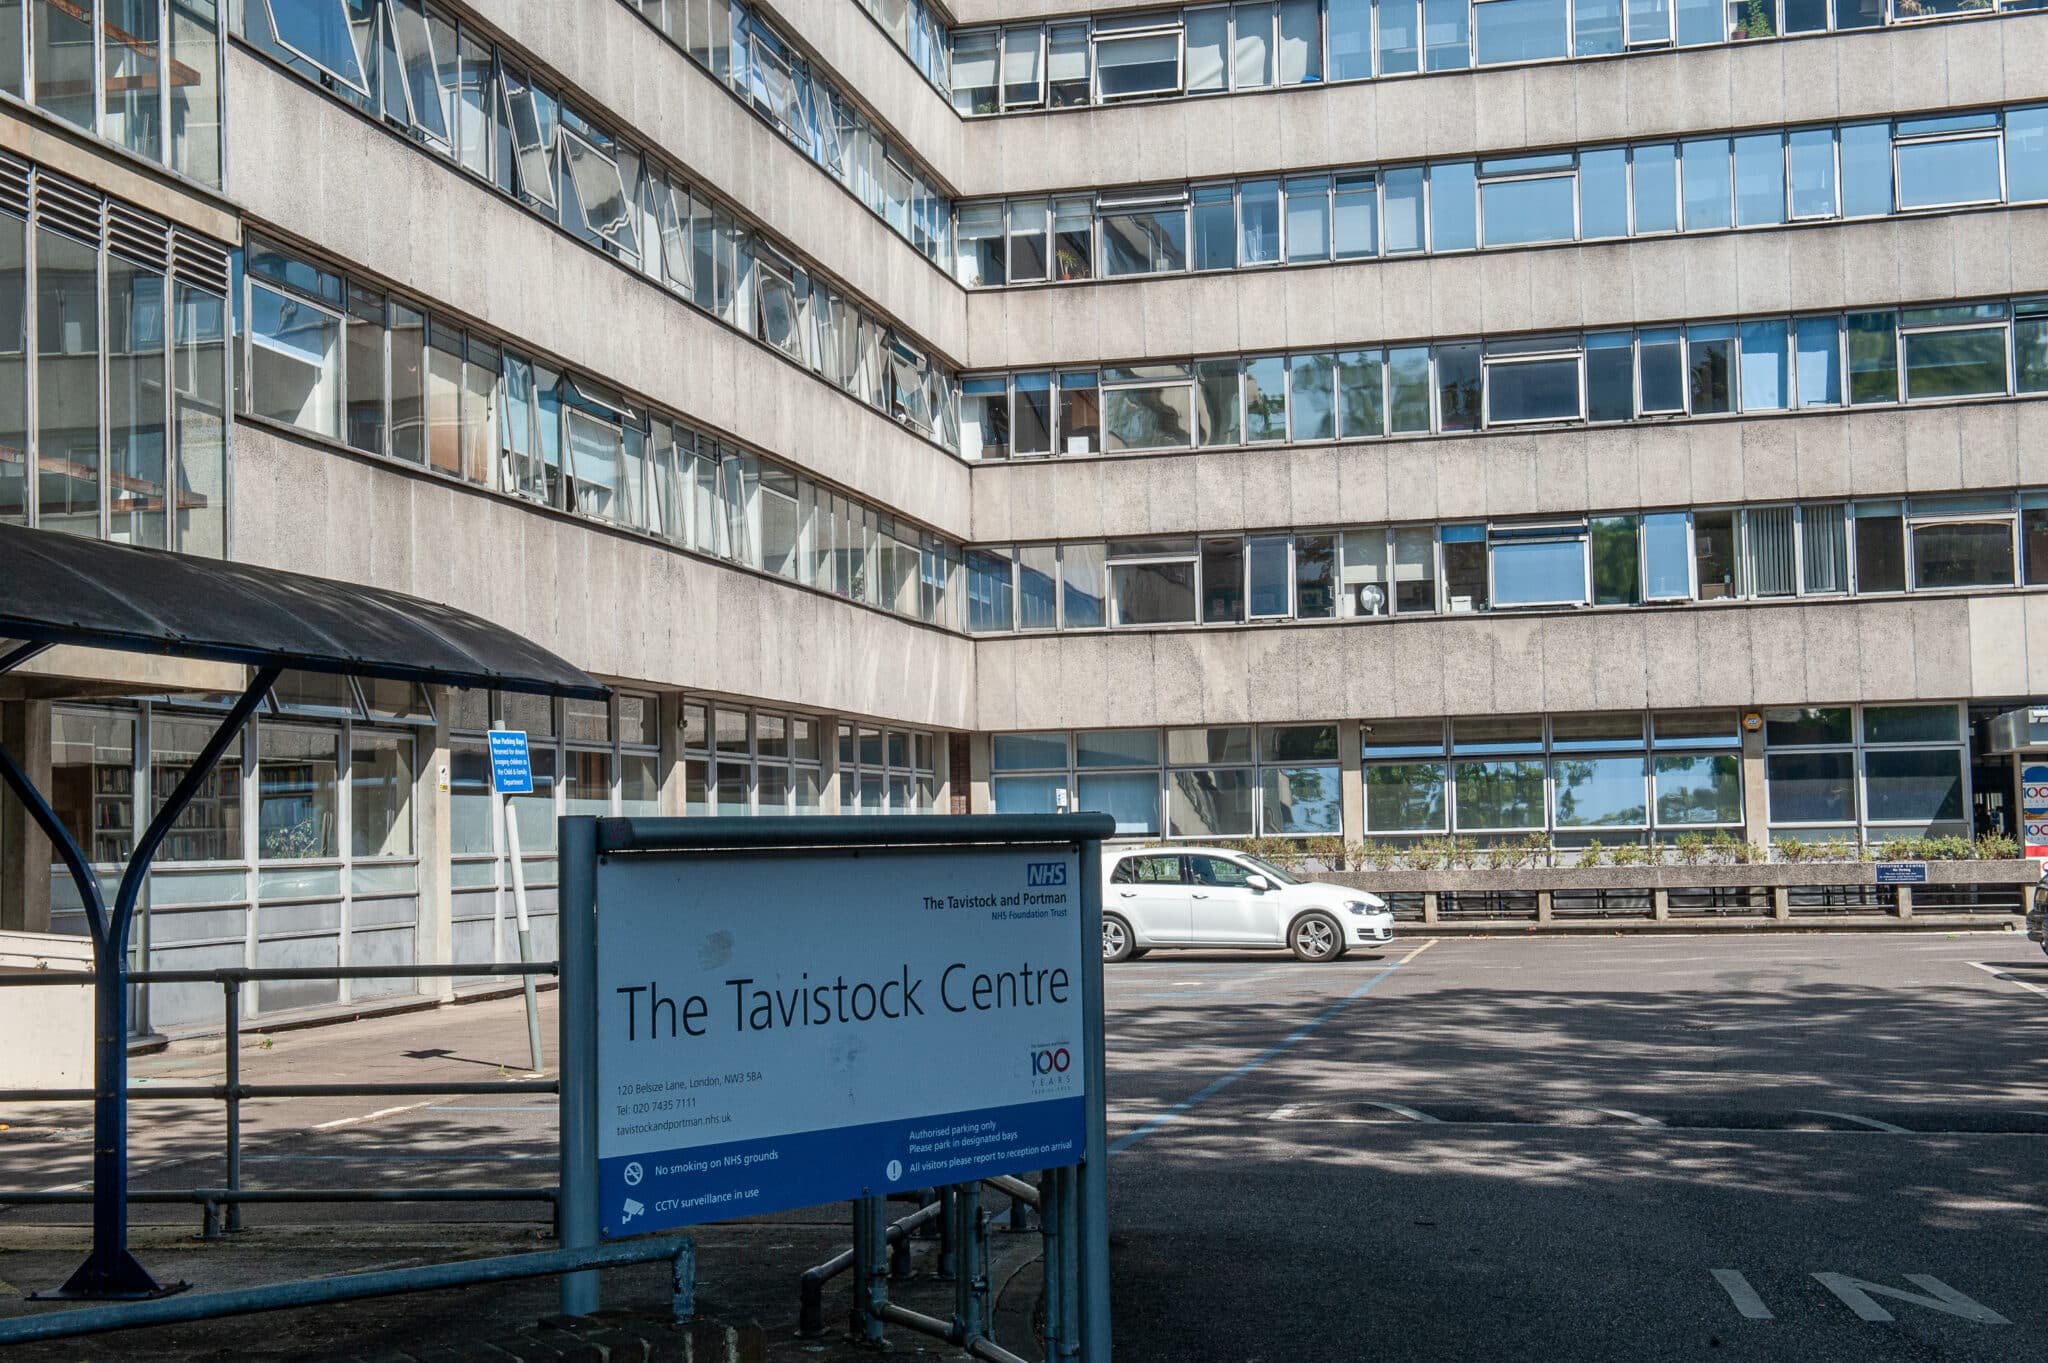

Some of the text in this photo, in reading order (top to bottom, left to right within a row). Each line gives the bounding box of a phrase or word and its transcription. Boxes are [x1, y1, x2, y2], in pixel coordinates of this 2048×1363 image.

[1028, 863, 1066, 885] NHS
[923, 892, 1067, 910] The Tavistock and Portman
[992, 908, 1067, 920] NHS Foundation Trust
[617, 962, 1069, 1041] The Tavistock Centre
[1031, 1048, 1070, 1076] 100
[617, 1071, 762, 1096] 120 Belsize Lane, London, NW3 5BA
[1032, 1075, 1071, 1087] YEARS
[617, 1098, 696, 1116] Tel: 020 7435 7111
[909, 1120, 997, 1140] Authorised parking only
[909, 1131, 1018, 1154] Please park in designated bays
[655, 1149, 779, 1176] No smoking on NHS grounds
[909, 1140, 1072, 1173] All visitors please report to reception on arrival
[655, 1188, 760, 1212] CCTV surveillance in use
[1709, 1268, 2013, 1324] IN
